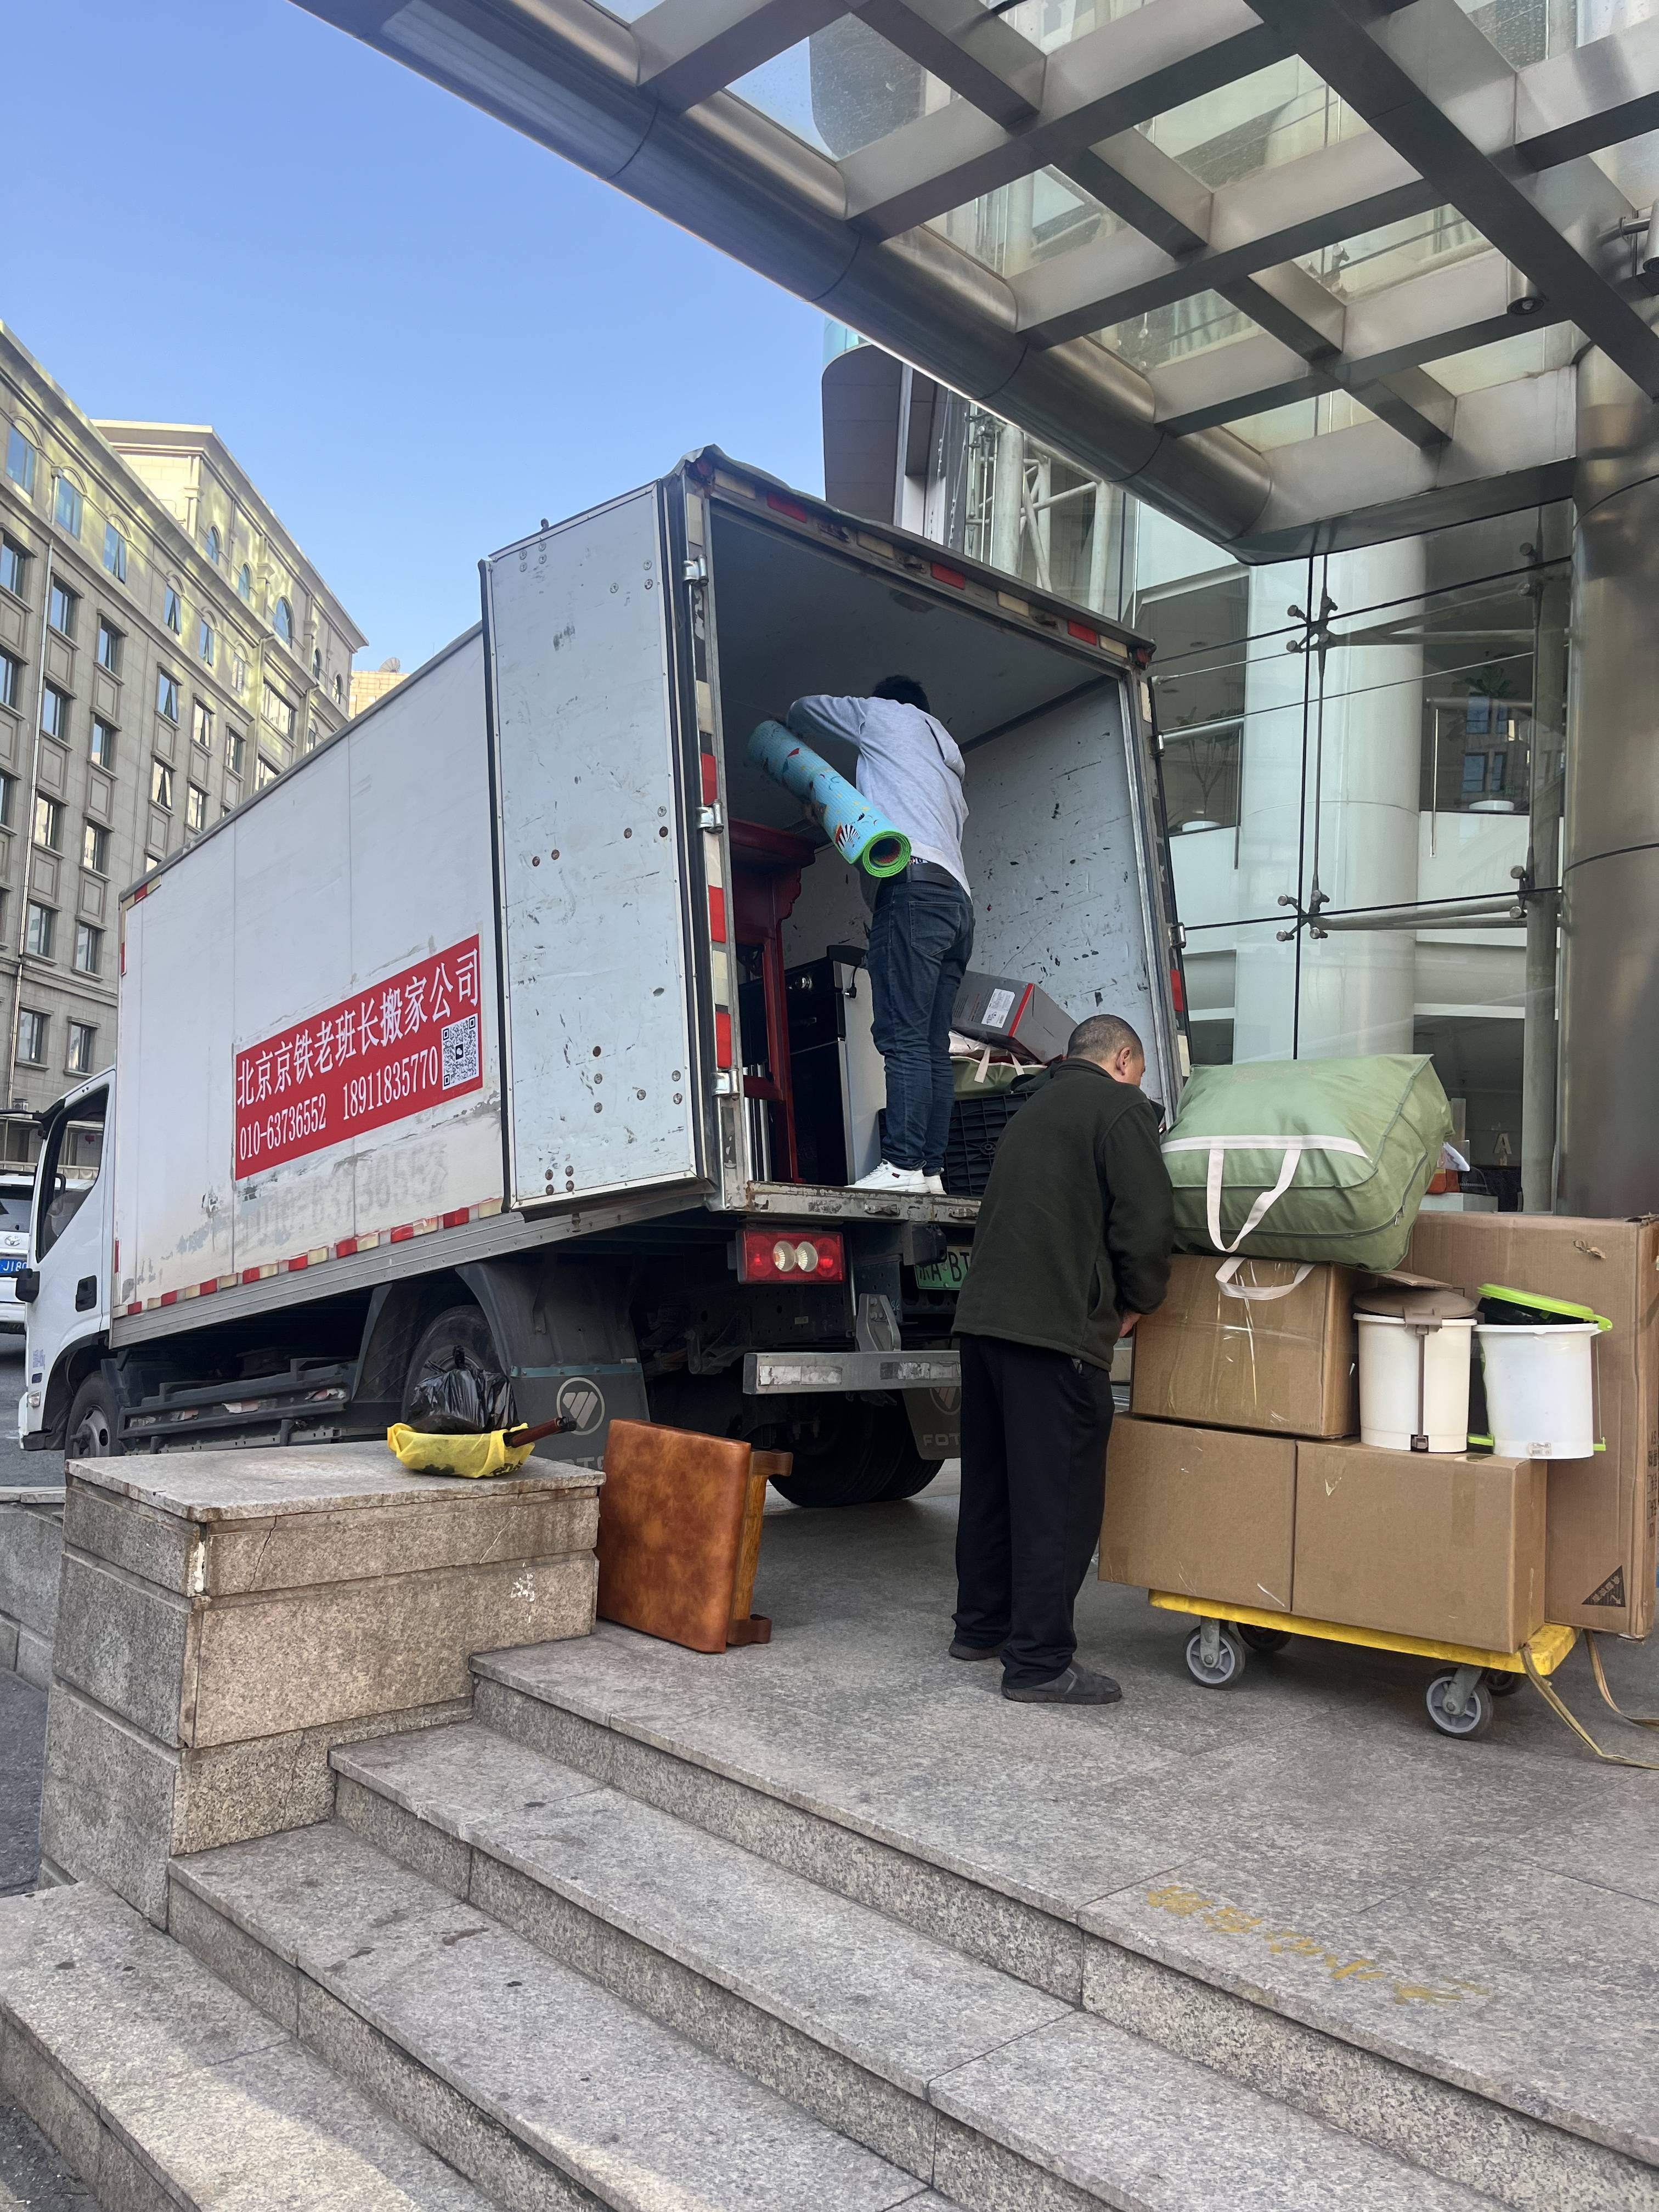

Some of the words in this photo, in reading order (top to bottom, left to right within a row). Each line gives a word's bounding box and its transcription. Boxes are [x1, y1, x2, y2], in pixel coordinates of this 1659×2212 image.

[237, 948, 478, 1109] 北京京铁老班长搬家公司
[239, 1092, 327, 1161] 010-63736552
[342, 1045, 439, 1121] 18911835770
